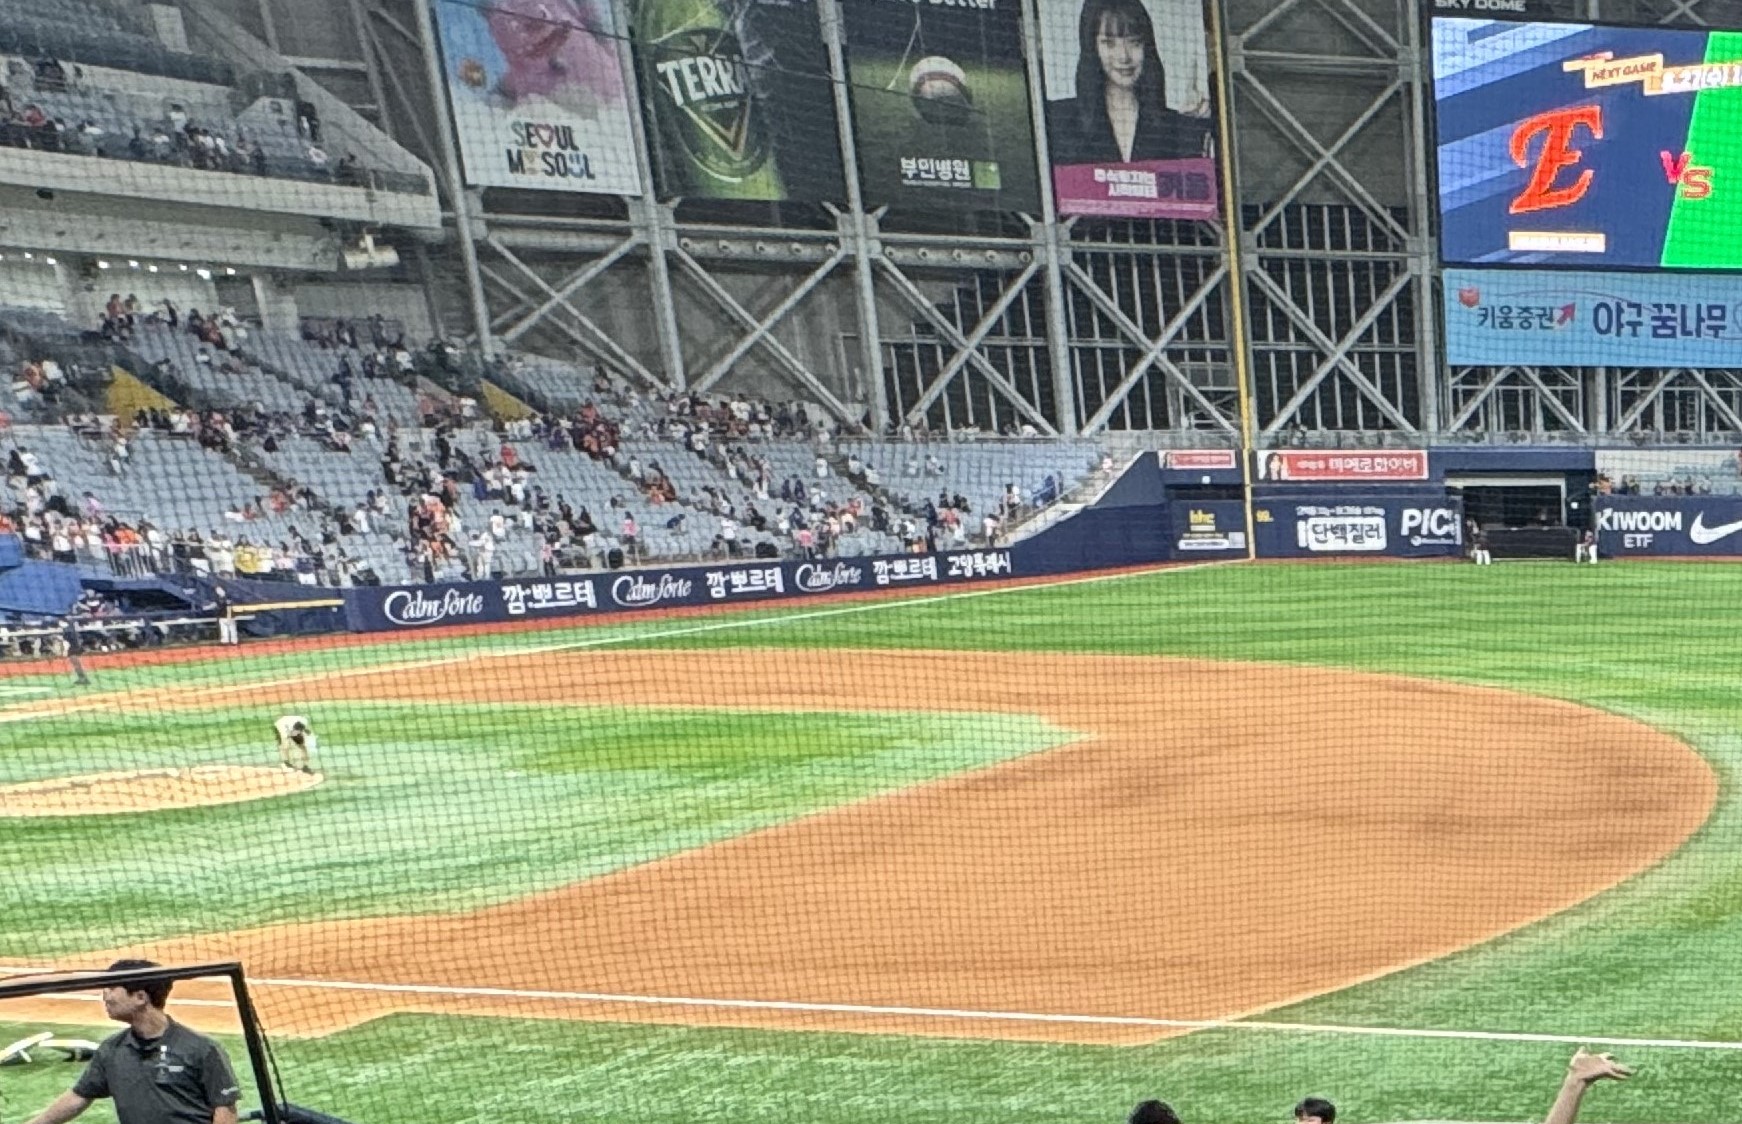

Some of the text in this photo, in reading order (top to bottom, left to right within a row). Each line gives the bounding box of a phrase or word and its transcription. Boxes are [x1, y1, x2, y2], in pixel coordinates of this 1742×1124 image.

[900, 157, 972, 181] 부민병원
[1508, 105, 1604, 215] E
[1478, 304, 1555, 331] 키움증권
[1592, 301, 1643, 337] 야구
[1650, 303, 1727, 340] 꿈나무
[1328, 457, 1418, 474] 미에로화이바
[1595, 507, 1682, 531] KIWOOM
[1623, 533, 1654, 548] ETF
